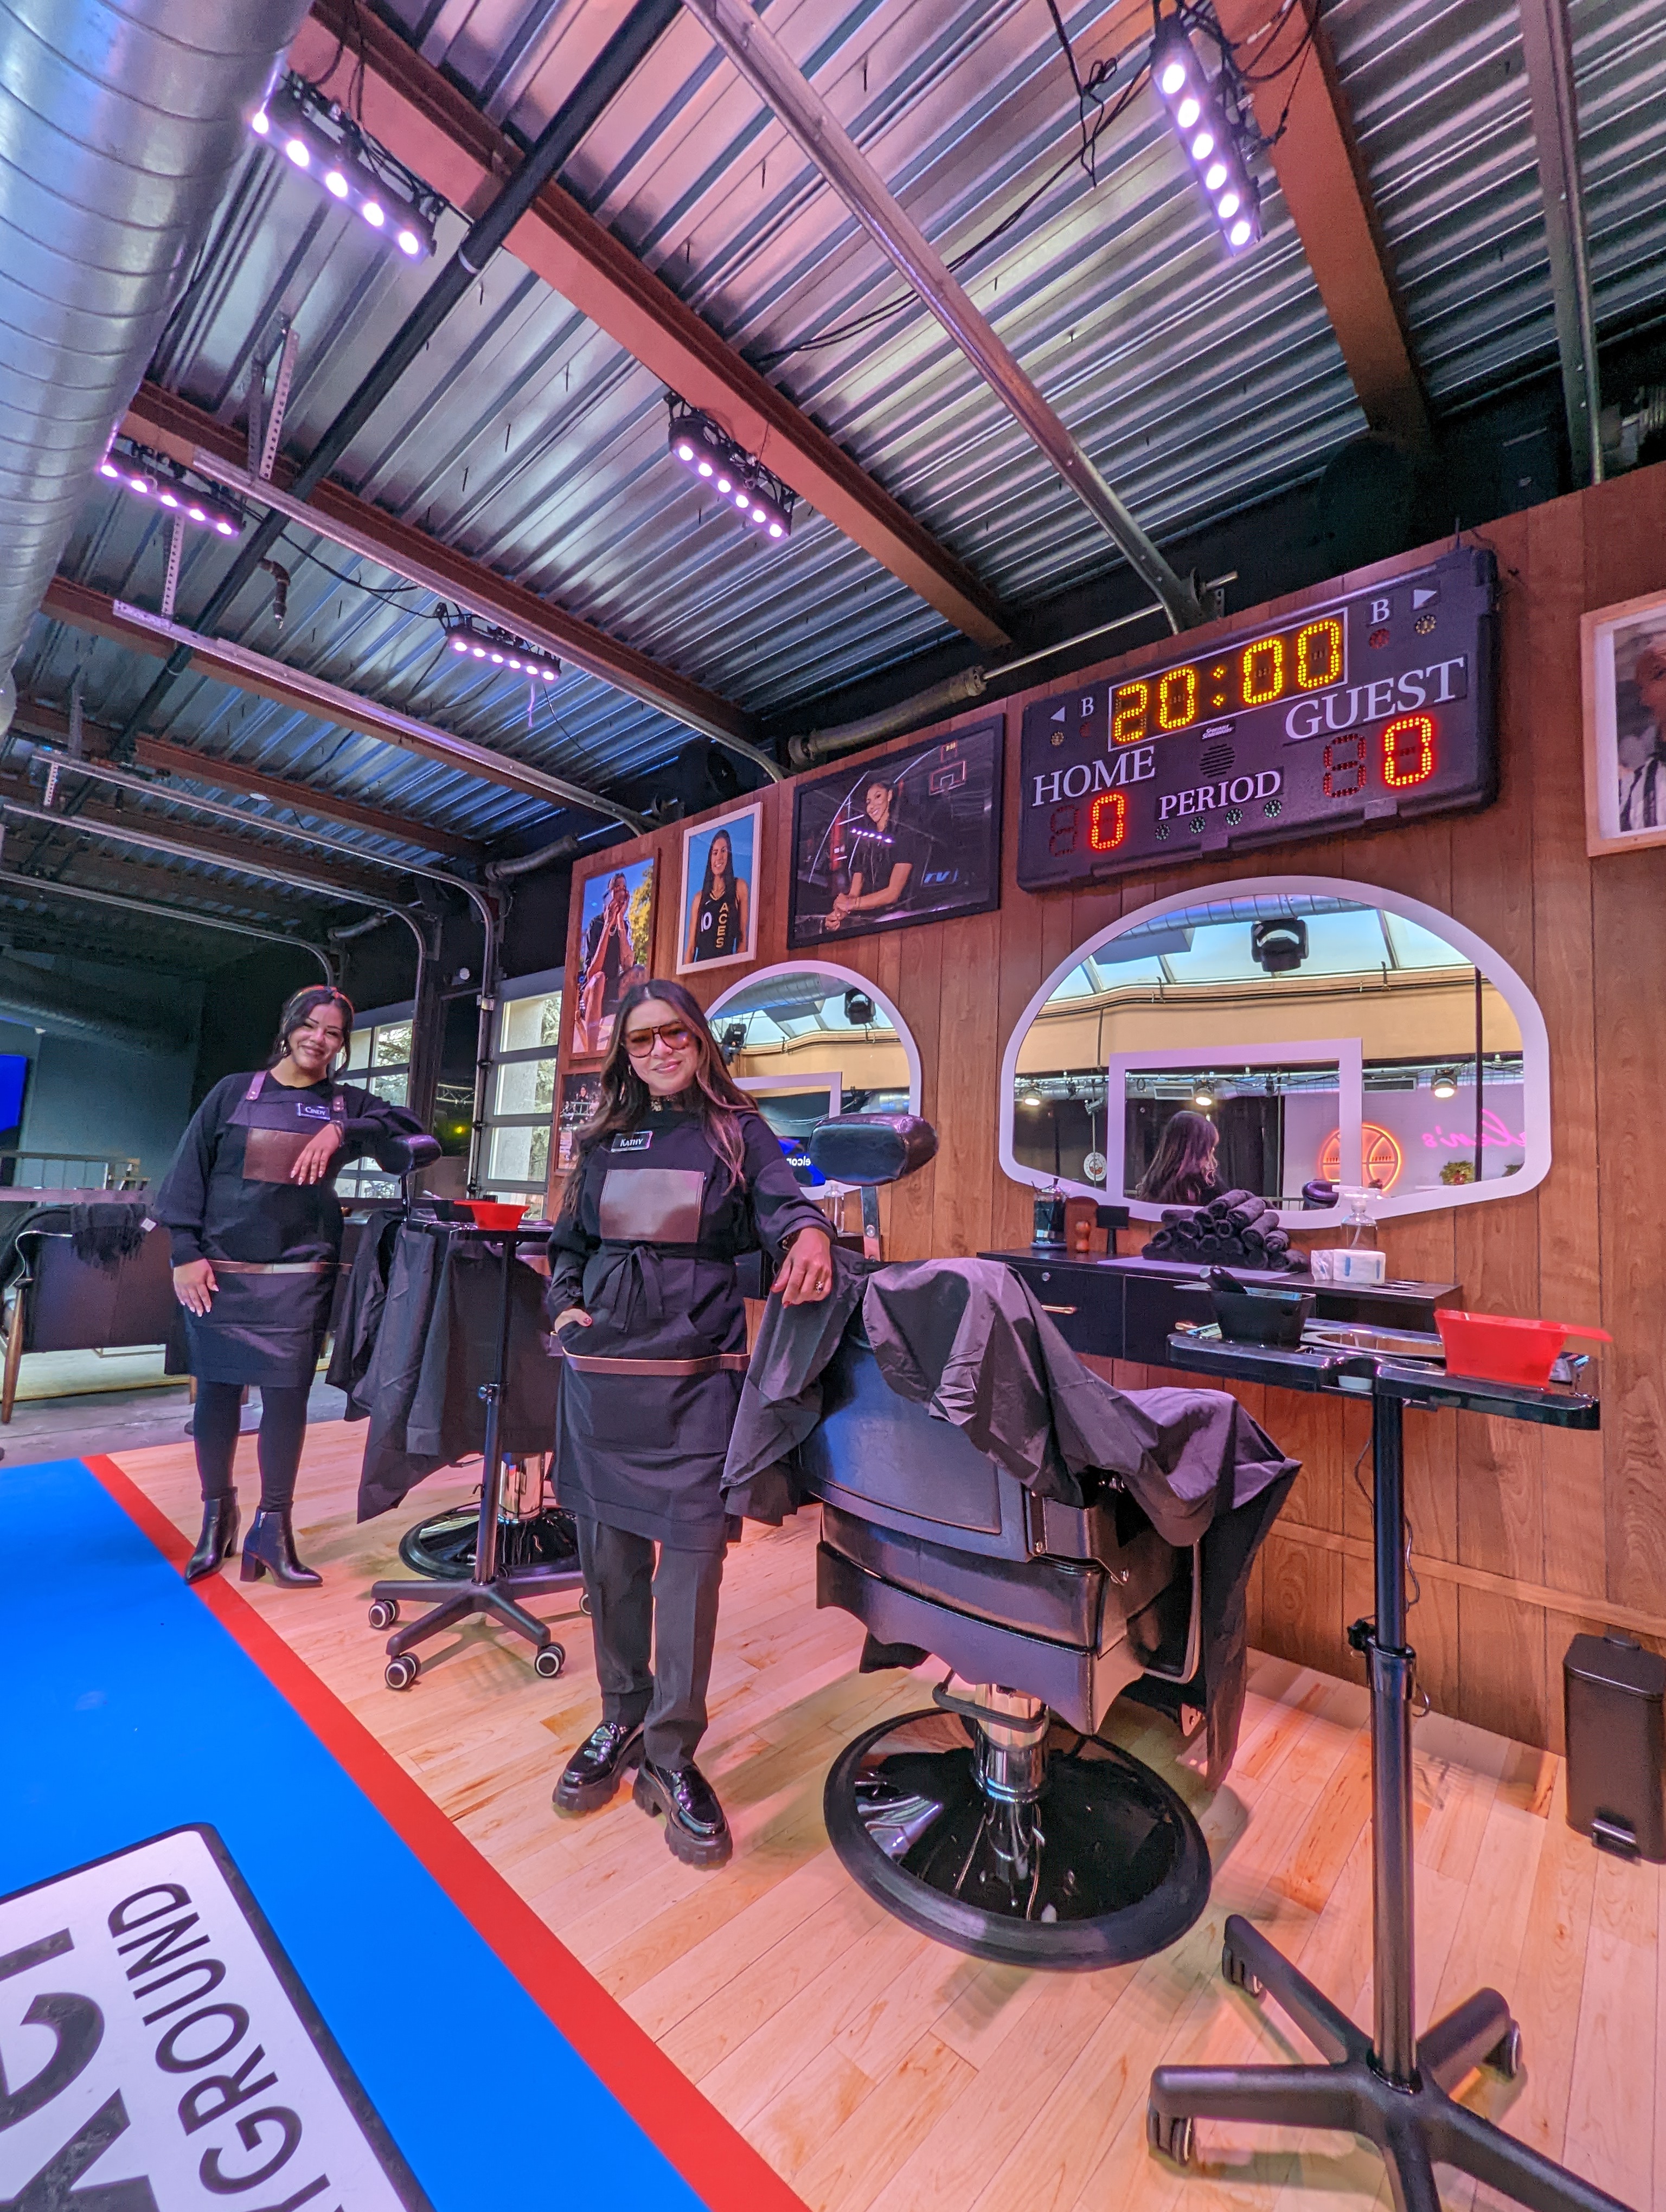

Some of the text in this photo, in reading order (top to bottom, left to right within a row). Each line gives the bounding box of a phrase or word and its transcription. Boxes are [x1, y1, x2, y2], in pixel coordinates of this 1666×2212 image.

[1370, 599, 1391, 624] B
[1114, 621, 1340, 742] 20:00
[1285, 657, 1464, 740] GUEST
[1081, 697, 1094, 718] B
[1032, 745, 1156, 807] HOME
[1158, 770, 1281, 820] PERIOD
[700, 911, 712, 932] 10
[715, 902, 729, 948] ACES
